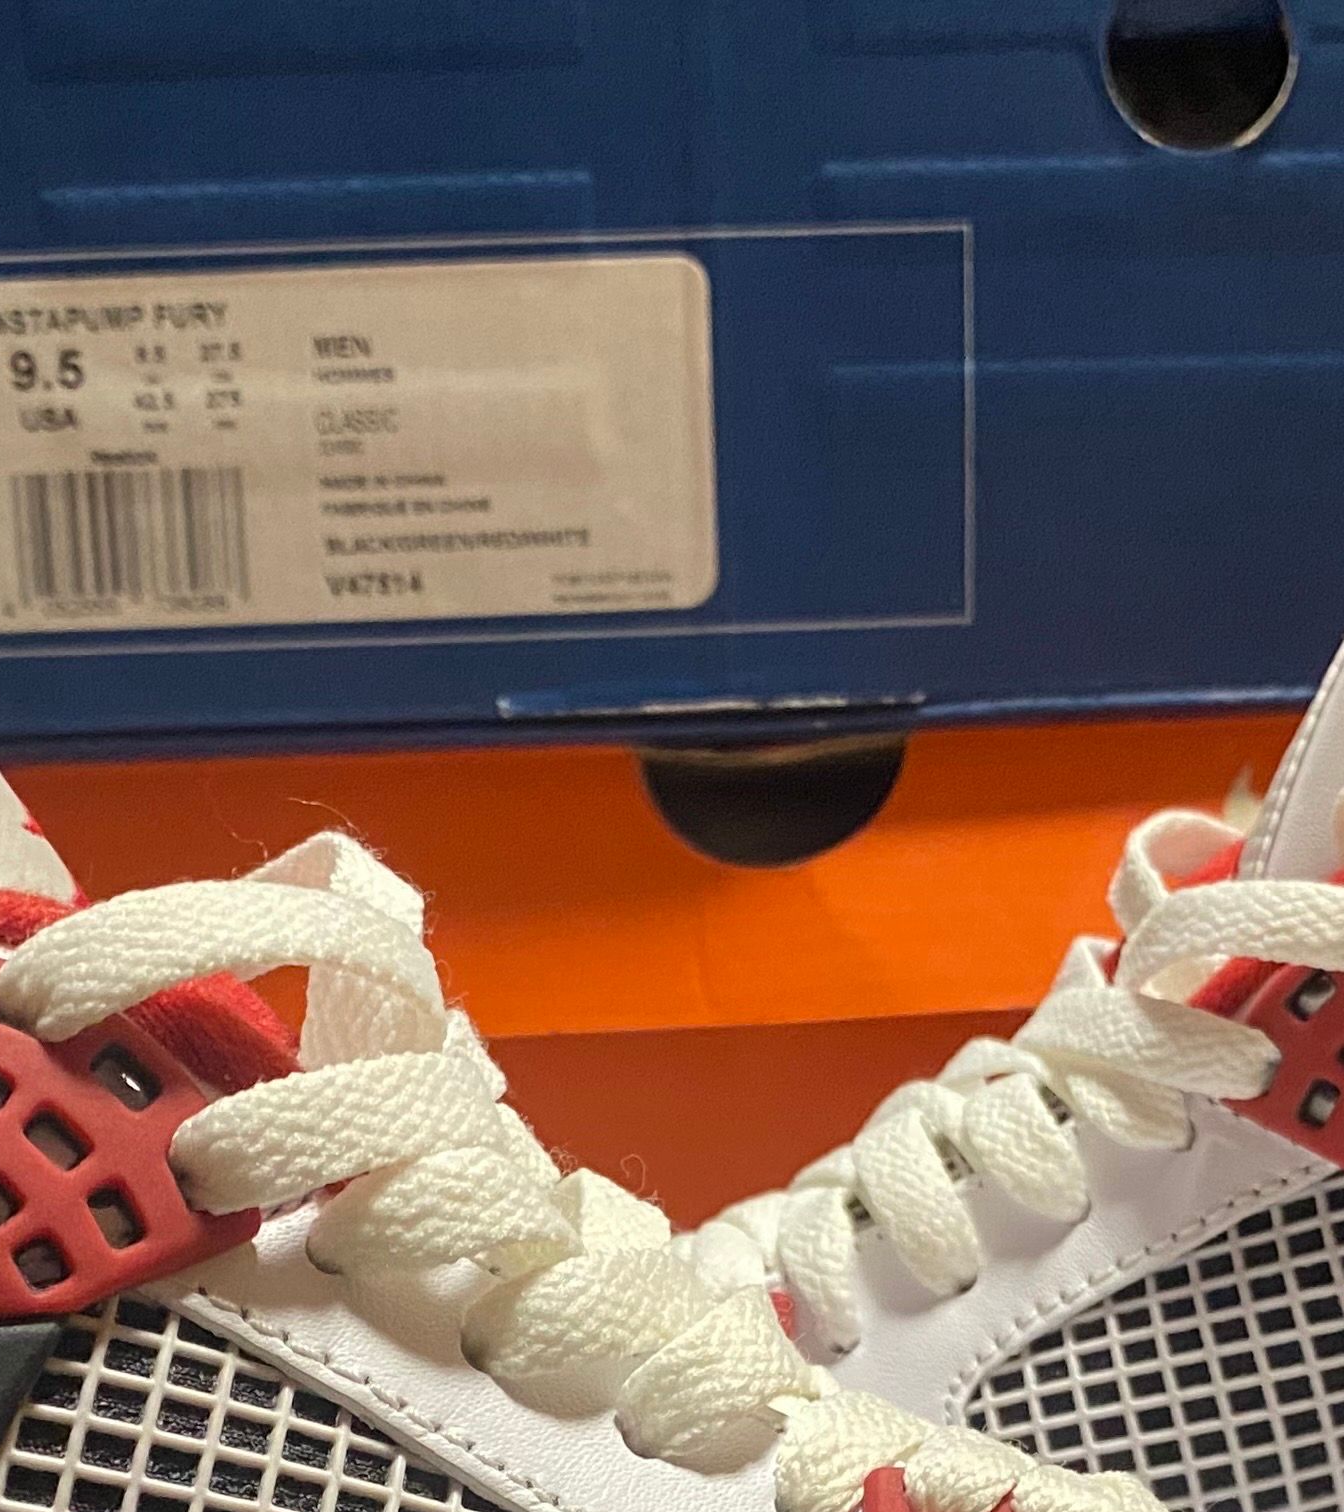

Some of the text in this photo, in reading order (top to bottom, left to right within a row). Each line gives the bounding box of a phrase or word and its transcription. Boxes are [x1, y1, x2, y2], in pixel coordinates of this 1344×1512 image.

[153, 302, 227, 332] FURY
[313, 335, 371, 358] MEN
[10, 350, 84, 390] 9.5
[19, 408, 78, 433] USA
[315, 408, 400, 435] CLASSIC
